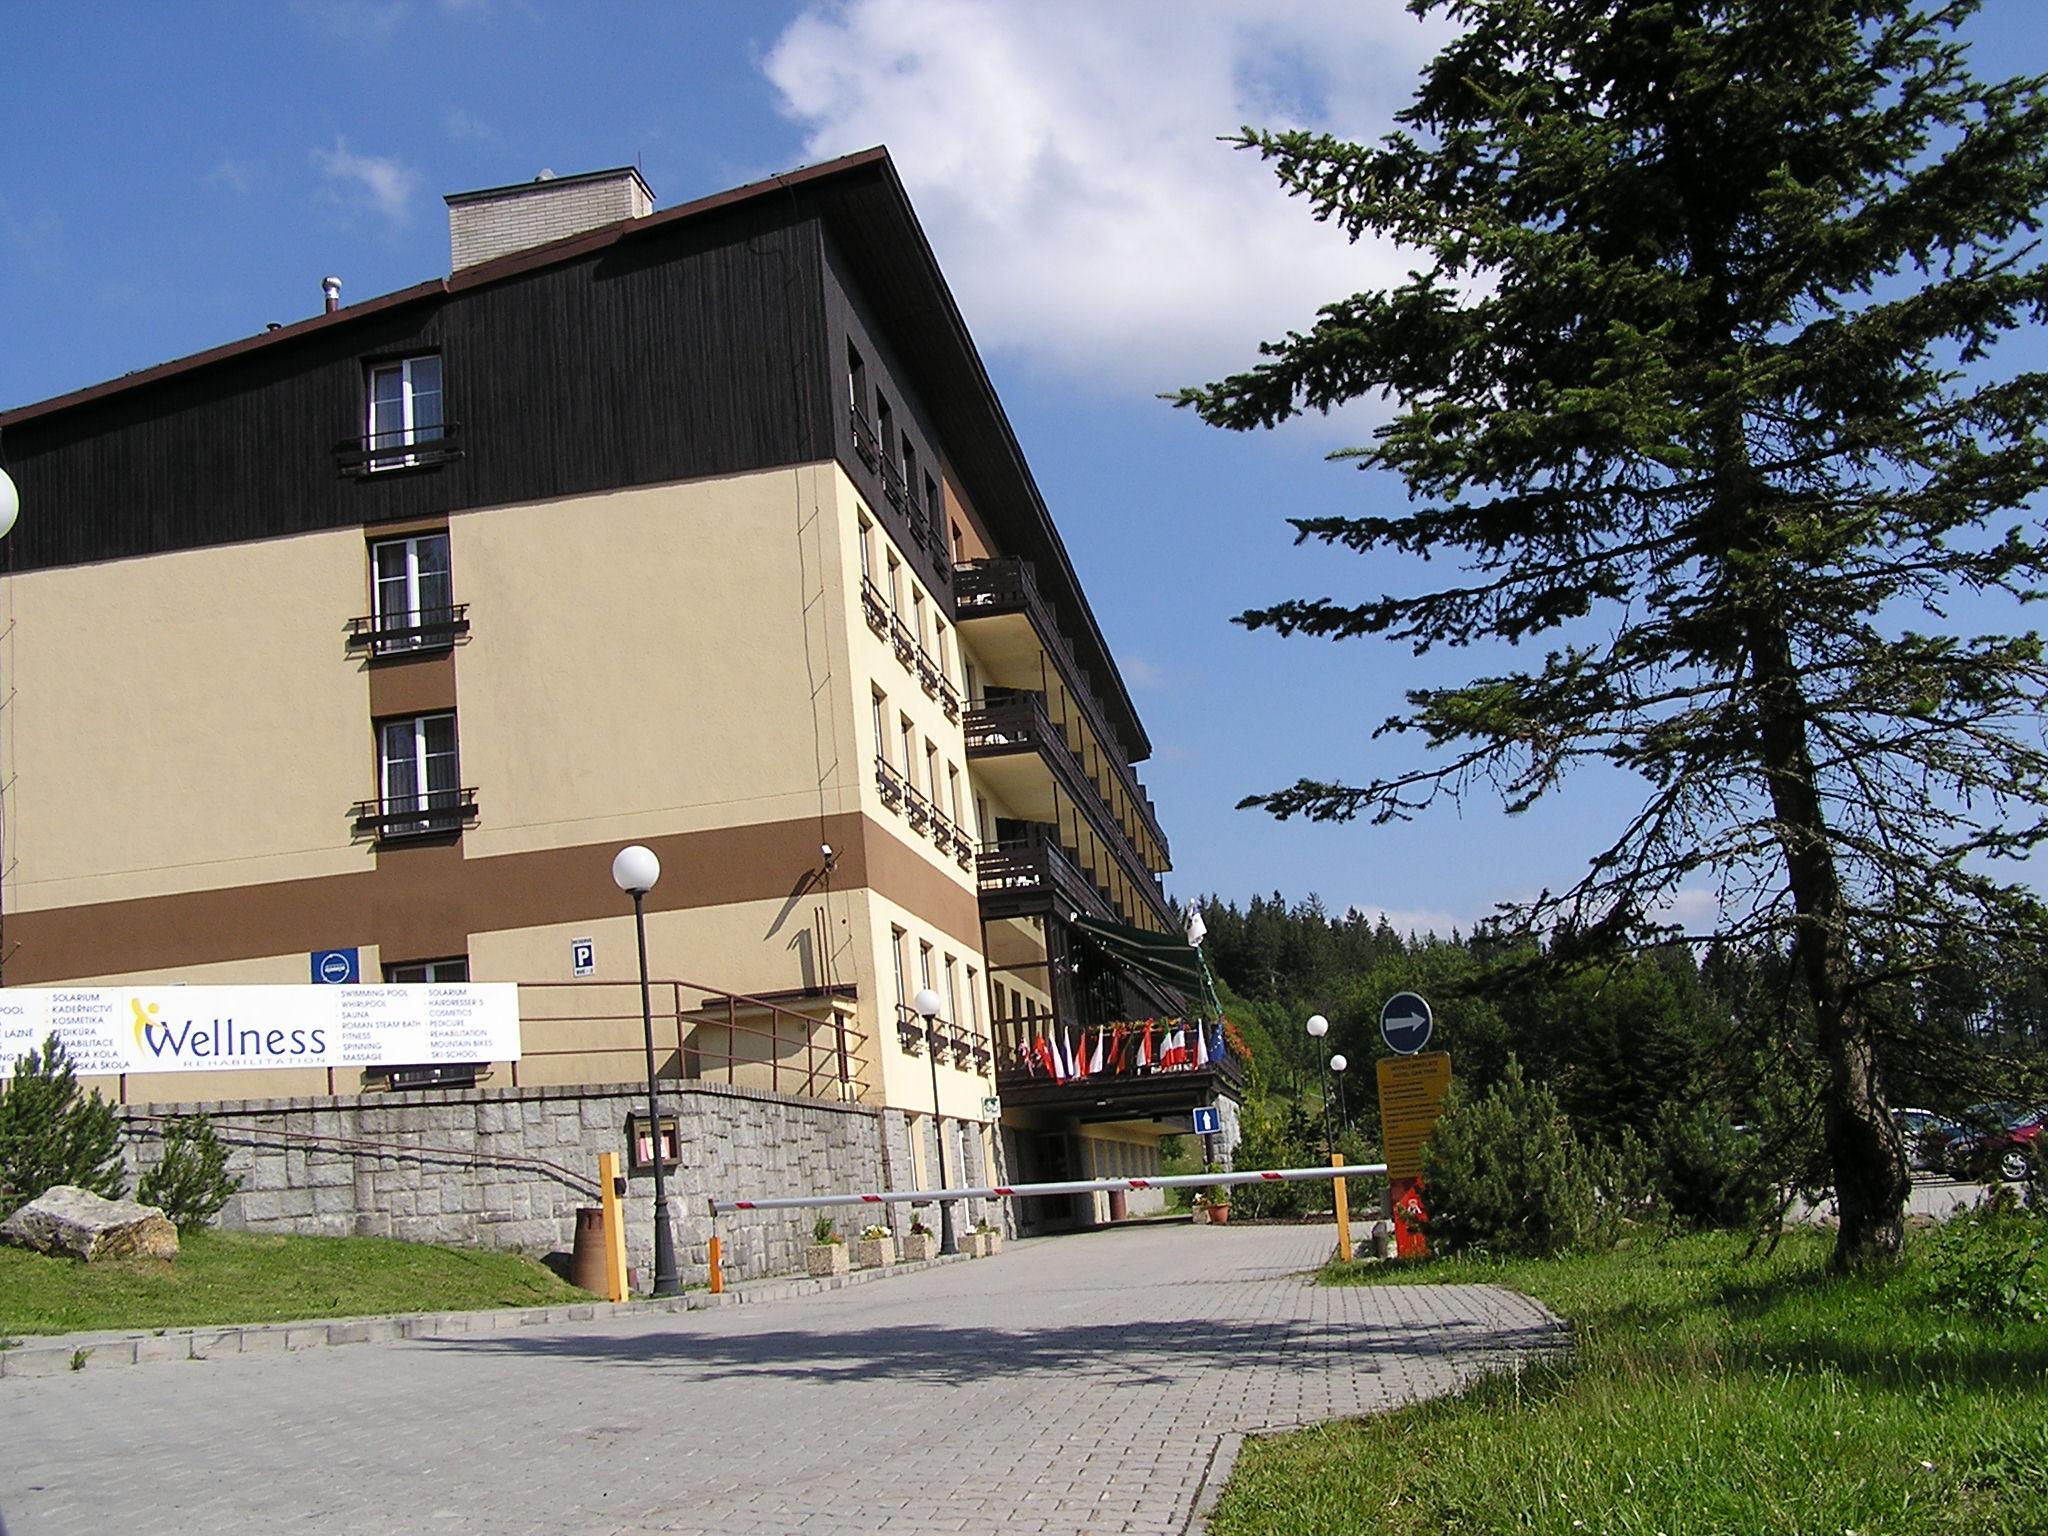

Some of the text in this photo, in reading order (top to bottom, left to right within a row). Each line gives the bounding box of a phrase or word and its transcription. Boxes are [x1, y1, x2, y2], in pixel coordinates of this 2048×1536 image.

[577, 947, 590, 966] P
[341, 989, 408, 998] SWIMMING POOL
[341, 1000, 387, 1008] WHIRLPOOL
[341, 1011, 370, 1019] SAUNA
[429, 1009, 472, 1017] COSMETICS
[52, 1016, 104, 1025] KOSMETIKA
[342, 1021, 373, 1029] ROMAN
[402, 1020, 421, 1028] BATH
[429, 1019, 464, 1027] PEDICURE
[145, 1018, 326, 1057] Wellness
[342, 1032, 371, 1040] FITNESS
[430, 1029, 487, 1037] REHABILITATION
[61, 1039, 114, 1048] HABILITACE
[343, 1042, 382, 1051] SPINNING
[430, 1040, 472, 1048] MOUNTAIN
[94, 1049, 119, 1058] KOLA
[342, 1053, 382, 1061] MASSAGE
[183, 1057, 326, 1067] REHABILITATION
